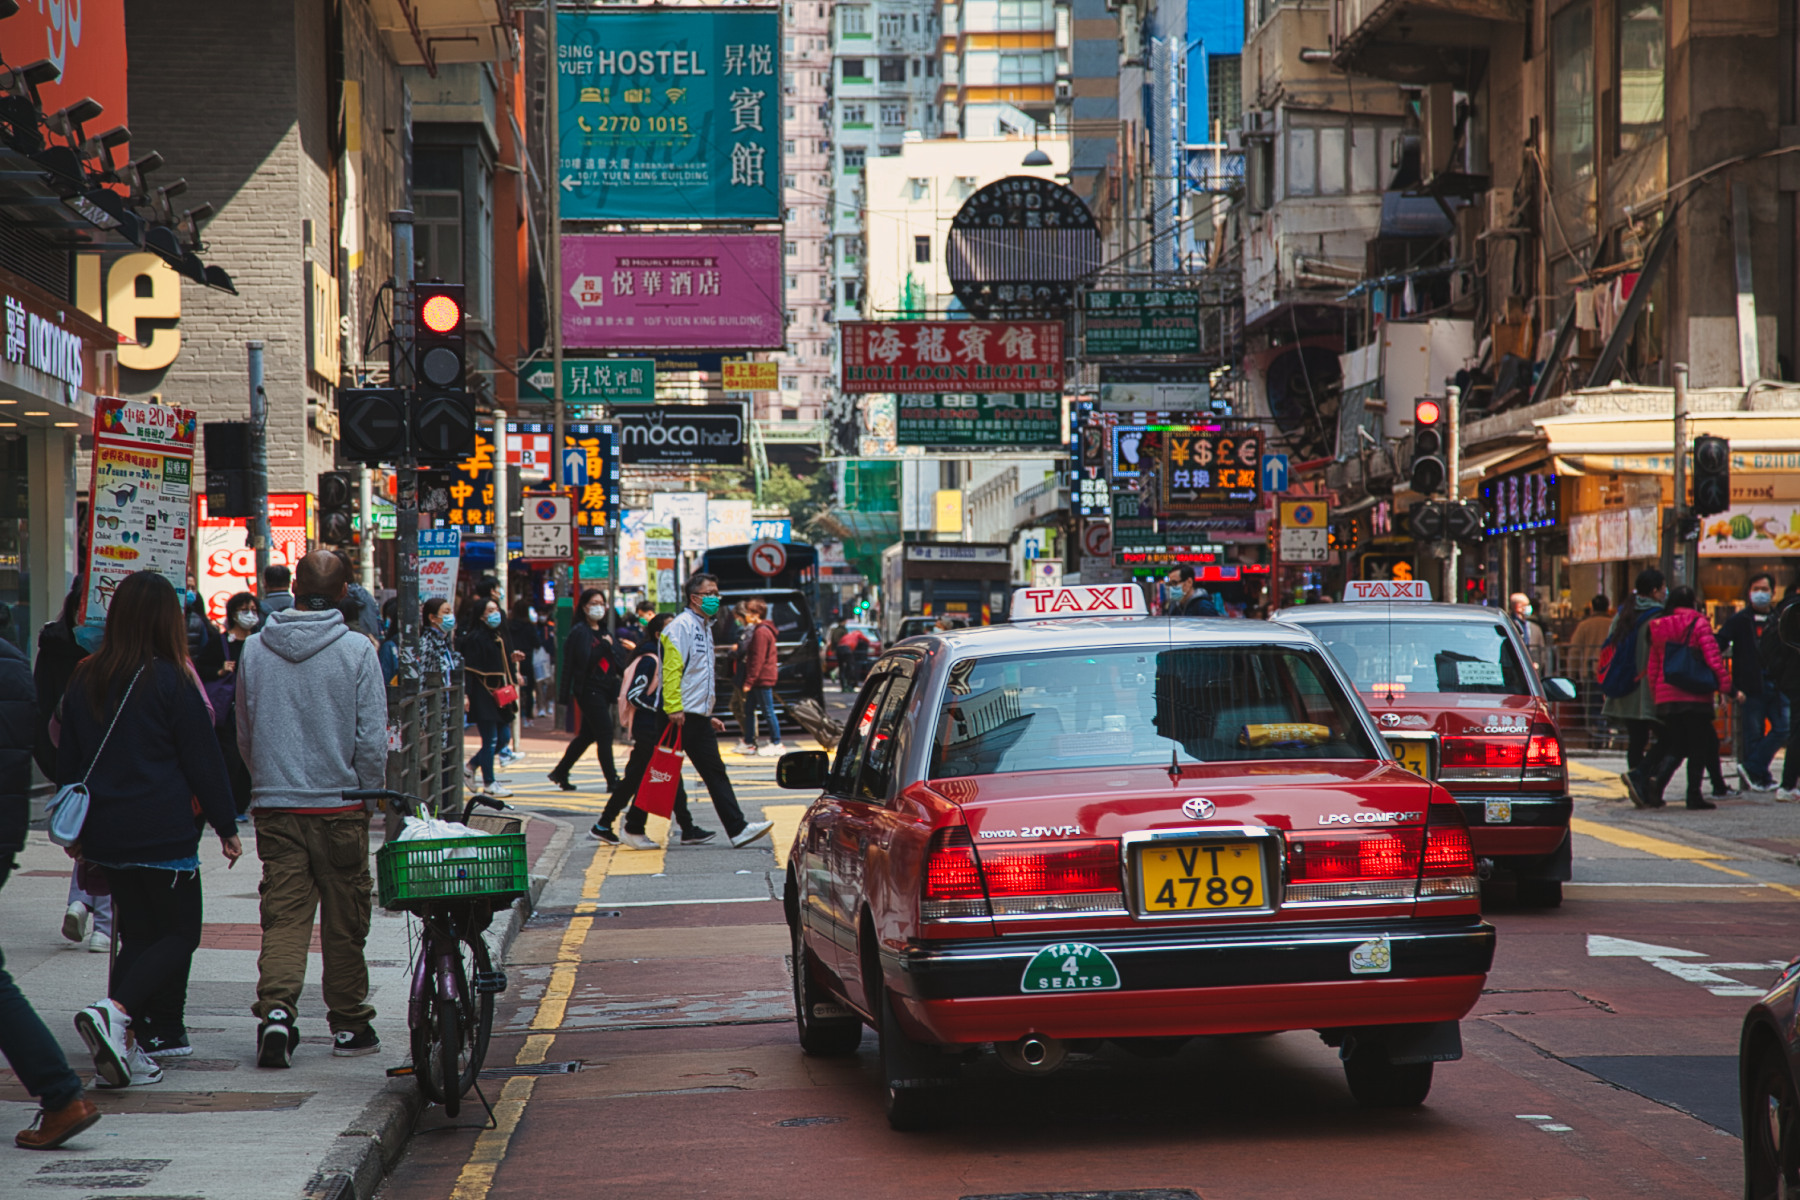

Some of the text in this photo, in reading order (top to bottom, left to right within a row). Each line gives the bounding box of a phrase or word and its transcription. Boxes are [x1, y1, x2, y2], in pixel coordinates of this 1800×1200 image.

[558, 45, 593, 58] SING
[559, 61, 593, 75] YUET
[599, 51, 706, 75] HOSTEL
[598, 116, 688, 132] 2770 1015
[603, 172, 631, 180] YUEN
[635, 172, 657, 180] KING
[661, 172, 709, 180] BUILDING
[664, 316, 690, 326] YUEN
[693, 316, 717, 326] KING
[719, 316, 763, 326] BUILDING
[868, 326, 1037, 364] 海龍賓館
[28, 312, 83, 400] mannings
[846, 364, 1060, 380] HOI LOON HOTEL
[846, 382, 879, 391] HOTEL
[994, 409, 1056, 419] HOTEL
[621, 424, 734, 445] moca hair
[1193, 438, 1213, 466] $
[1217, 438, 1234, 465] £
[1238, 438, 1257, 465] €
[553, 526, 561, 537] 7
[1310, 530, 1318, 541] 7
[554, 544, 568, 556] 12
[1311, 548, 1326, 558] 12
[207, 541, 296, 577] sae!
[1353, 582, 1424, 598] TAXI
[1026, 585, 1134, 613] TAXI
[1484, 726, 1528, 734] COMFORT
[1318, 811, 1423, 825] LPG COMFORT
[979, 829, 1017, 839] TOYOTA
[1176, 846, 1225, 877] VT
[1153, 877, 1255, 910] 4789
[1048, 943, 1093, 959] TAXI
[1061, 956, 1079, 976] 4
[1038, 976, 1103, 989] SEATS
